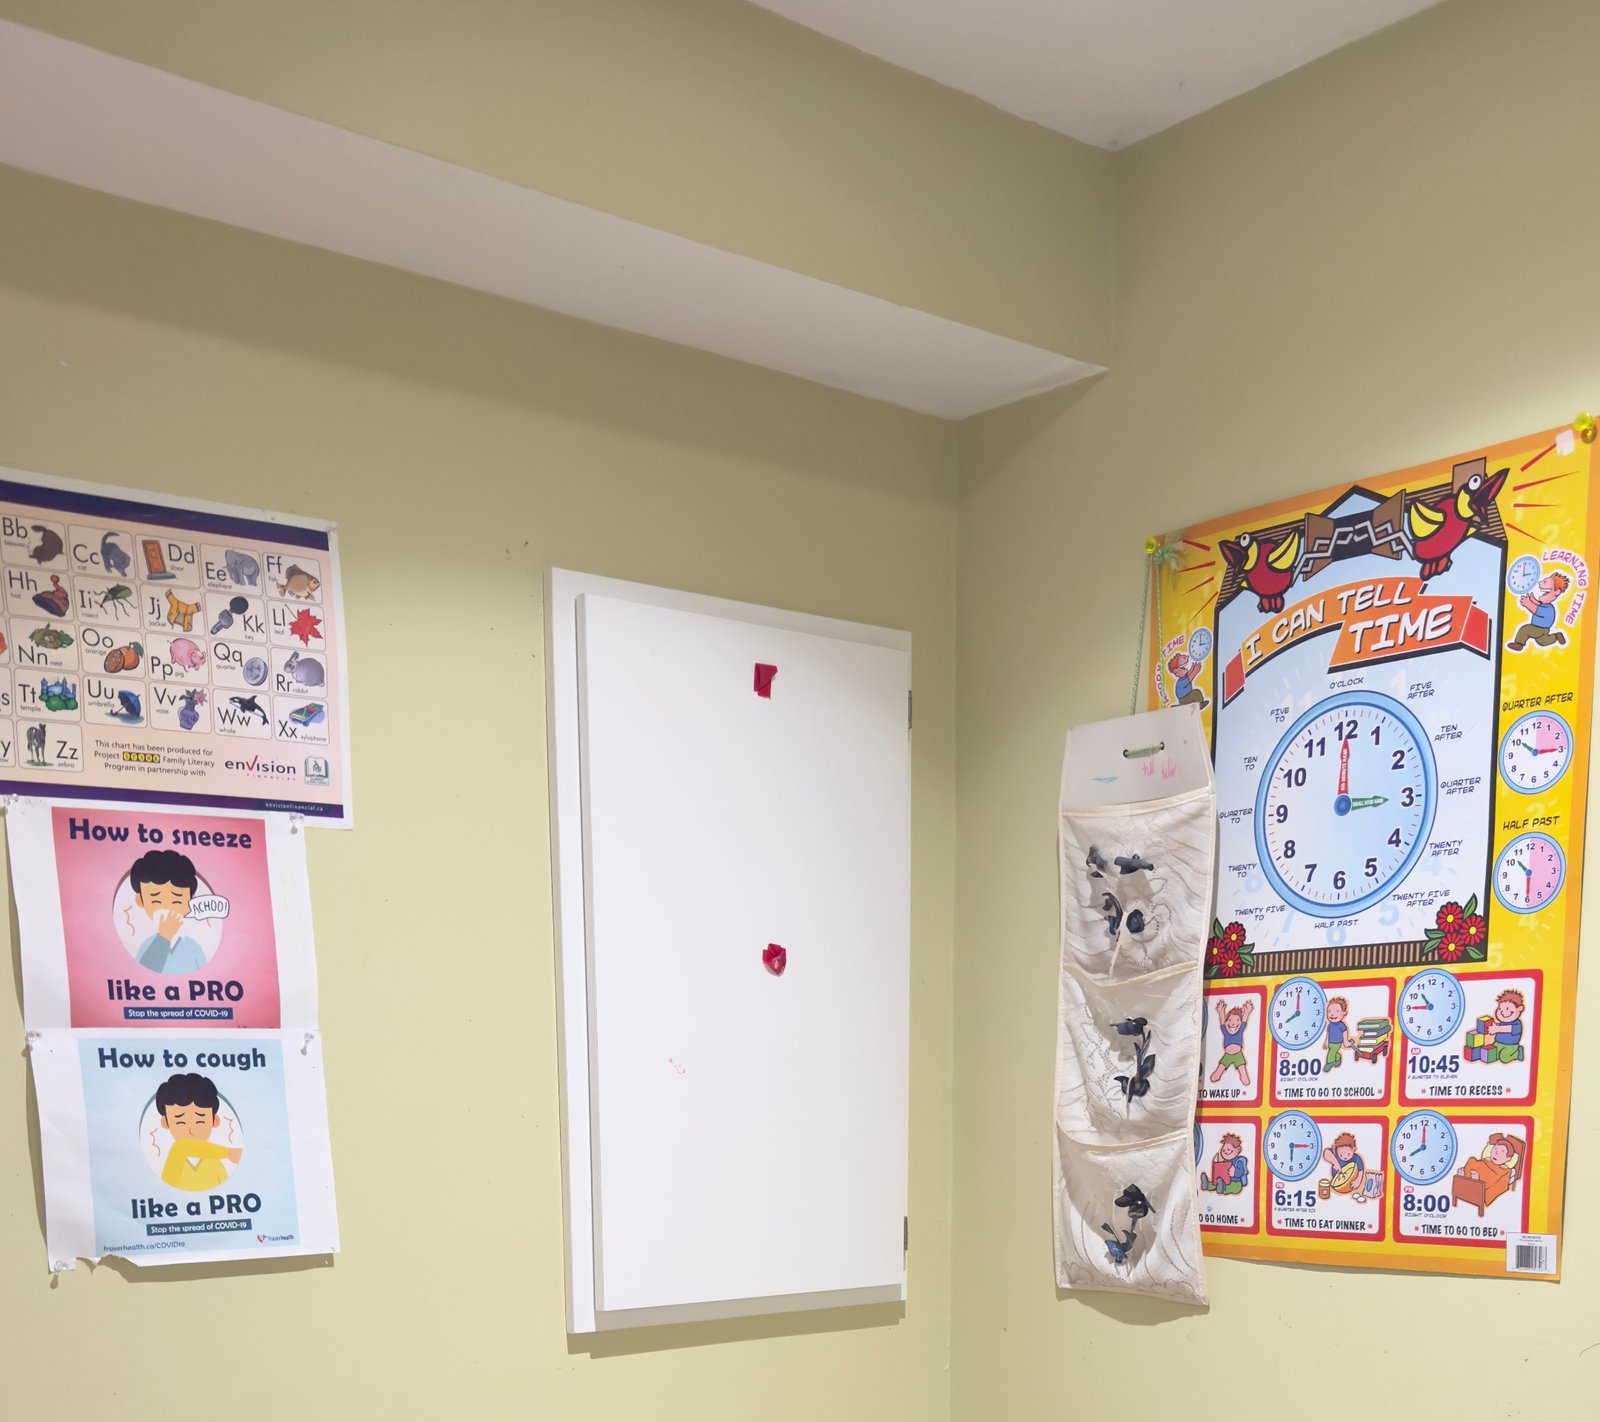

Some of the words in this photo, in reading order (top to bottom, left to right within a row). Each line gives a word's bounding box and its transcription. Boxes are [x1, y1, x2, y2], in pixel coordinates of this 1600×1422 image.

[2, 517, 28, 538] Bb
[73, 544, 100, 564] Cc
[168, 543, 195, 564] Dd
[205, 562, 227, 581] Ee
[266, 555, 282, 574] Ff
[8, 570, 37, 592] Hh
[1542, 550, 1587, 588] LEARNING
[1565, 592, 1585, 626] TIME
[79, 589, 92, 609] Ii
[148, 597, 161, 620] Jj
[243, 614, 265, 634] Kk
[272, 608, 286, 626] Ll
[1246, 632, 1264, 666] I
[1271, 598, 1326, 644] CAN
[1337, 581, 1413, 615] TELL
[82, 628, 114, 648] Oo
[1348, 603, 1454, 655] TIME
[18, 644, 48, 665] Nn
[213, 642, 243, 668] Qq
[151, 656, 173, 680] Pp
[87, 679, 114, 700] Uu
[276, 674, 293, 692] Rr
[1329, 676, 1365, 690] O'CLOCK
[1409, 681, 1433, 692] FIVE
[18, 683, 37, 704] Tt
[154, 686, 177, 706] Vv
[1407, 689, 1436, 700] AFTER
[1502, 696, 1542, 712] QUARTER
[1544, 691, 1574, 705] AFTER
[217, 706, 251, 727] Ww
[1270, 706, 1290, 717] FIVE
[278, 719, 299, 739] Xx
[1333, 719, 1359, 742] 12
[1370, 725, 1382, 746] 1
[1434, 731, 1463, 742] AFTER
[1440, 724, 1458, 733] TEN
[56, 740, 79, 760] Zz
[95, 740, 110, 748] This
[111, 741, 131, 750] chart
[132, 743, 145, 751] has
[146, 744, 166, 753] been
[166, 746, 201, 757] produced
[202, 747, 213, 756] for
[1303, 736, 1326, 759] 11
[94, 750, 120, 761] Project
[162, 755, 186, 766] Family
[187, 757, 215, 768] Literacy
[224, 755, 296, 775] envision
[1243, 755, 1259, 764] TEN
[1245, 763, 1256, 771] TO
[1391, 749, 1406, 771] 2
[104, 762, 137, 773] Program
[138, 764, 146, 772] in
[146, 765, 189, 777] partnership
[190, 768, 206, 777] with
[1283, 767, 1307, 788] 10
[1440, 776, 1482, 790] QUARTER
[1446, 785, 1475, 796] AFTER
[1400, 786, 1415, 808] 3
[265, 802, 324, 812] envisionfinancial.ca
[1218, 807, 1253, 820] QUARTER
[1275, 804, 1289, 824] 9
[1502, 818, 1530, 831] HALF
[1531, 815, 1561, 828] PAST
[69, 817, 129, 842] How
[137, 823, 164, 844] to
[172, 827, 252, 849] sneeze
[1387, 827, 1402, 848] 4
[1283, 839, 1297, 860] 8
[1428, 839, 1464, 850] TWENTY
[1431, 847, 1460, 857] AFTER
[1228, 862, 1258, 872] TWENTY
[1304, 863, 1318, 884] 7
[1363, 857, 1378, 878] 5
[1332, 870, 1347, 891] 6
[1392, 891, 1427, 901] TWENTY
[1427, 889, 1451, 898] FIVE
[1406, 898, 1434, 907] AFTER
[192, 900, 228, 917] ACHOO!
[1234, 906, 1264, 916] TWENTY
[1265, 904, 1286, 913] FIVE
[1314, 920, 1336, 929] HALF
[1337, 918, 1359, 928] PAST
[107, 979, 156, 1001] like
[164, 986, 180, 1001] a
[188, 980, 244, 1002] PRO
[128, 1008, 145, 1018] Stop
[147, 1008, 159, 1018] the
[160, 1008, 185, 1018] spread
[185, 1008, 194, 1017] of
[194, 1009, 229, 1018] COVID-19
[97, 1047, 155, 1069] How
[163, 1049, 188, 1068] to
[195, 1047, 266, 1071] cough
[1279, 1058, 1322, 1077] 8:00
[1408, 1055, 1460, 1074] 10:45
[1198, 1088, 1208, 1098] TO
[1209, 1088, 1230, 1099] WAKE
[1231, 1088, 1241, 1098] UP
[1284, 1087, 1304, 1098] TIME
[1306, 1087, 1316, 1098] TO
[1318, 1087, 1329, 1097] GO
[1332, 1086, 1342, 1097] TO
[1343, 1086, 1376, 1097] SCHOOL
[1429, 1085, 1453, 1097] TIME
[1455, 1085, 1467, 1096] TO
[1469, 1085, 1504, 1096] RECESS
[131, 1198, 178, 1219] like
[186, 1202, 201, 1216] a
[208, 1192, 262, 1215] PRO
[1275, 1189, 1317, 1208] 6:15
[1403, 1193, 1451, 1213] 8:00
[151, 1225, 168, 1234] Stop
[168, 1224, 181, 1233] the
[181, 1223, 206, 1233] spread
[206, 1222, 214, 1231] of
[214, 1221, 248, 1230] COVID-19
[1204, 1213, 1215, 1223] GO
[1216, 1214, 1239, 1225] HOME
[1284, 1217, 1305, 1229] TIME
[1306, 1218, 1317, 1229] TO
[1318, 1219, 1335, 1230] EAT
[1335, 1219, 1367, 1231] DINNER
[1421, 1223, 1442, 1235] TIME
[1443, 1225, 1455, 1236] TO
[1456, 1225, 1468, 1236] GO
[1469, 1226, 1481, 1237] TO
[1482, 1226, 1498, 1238] BED
